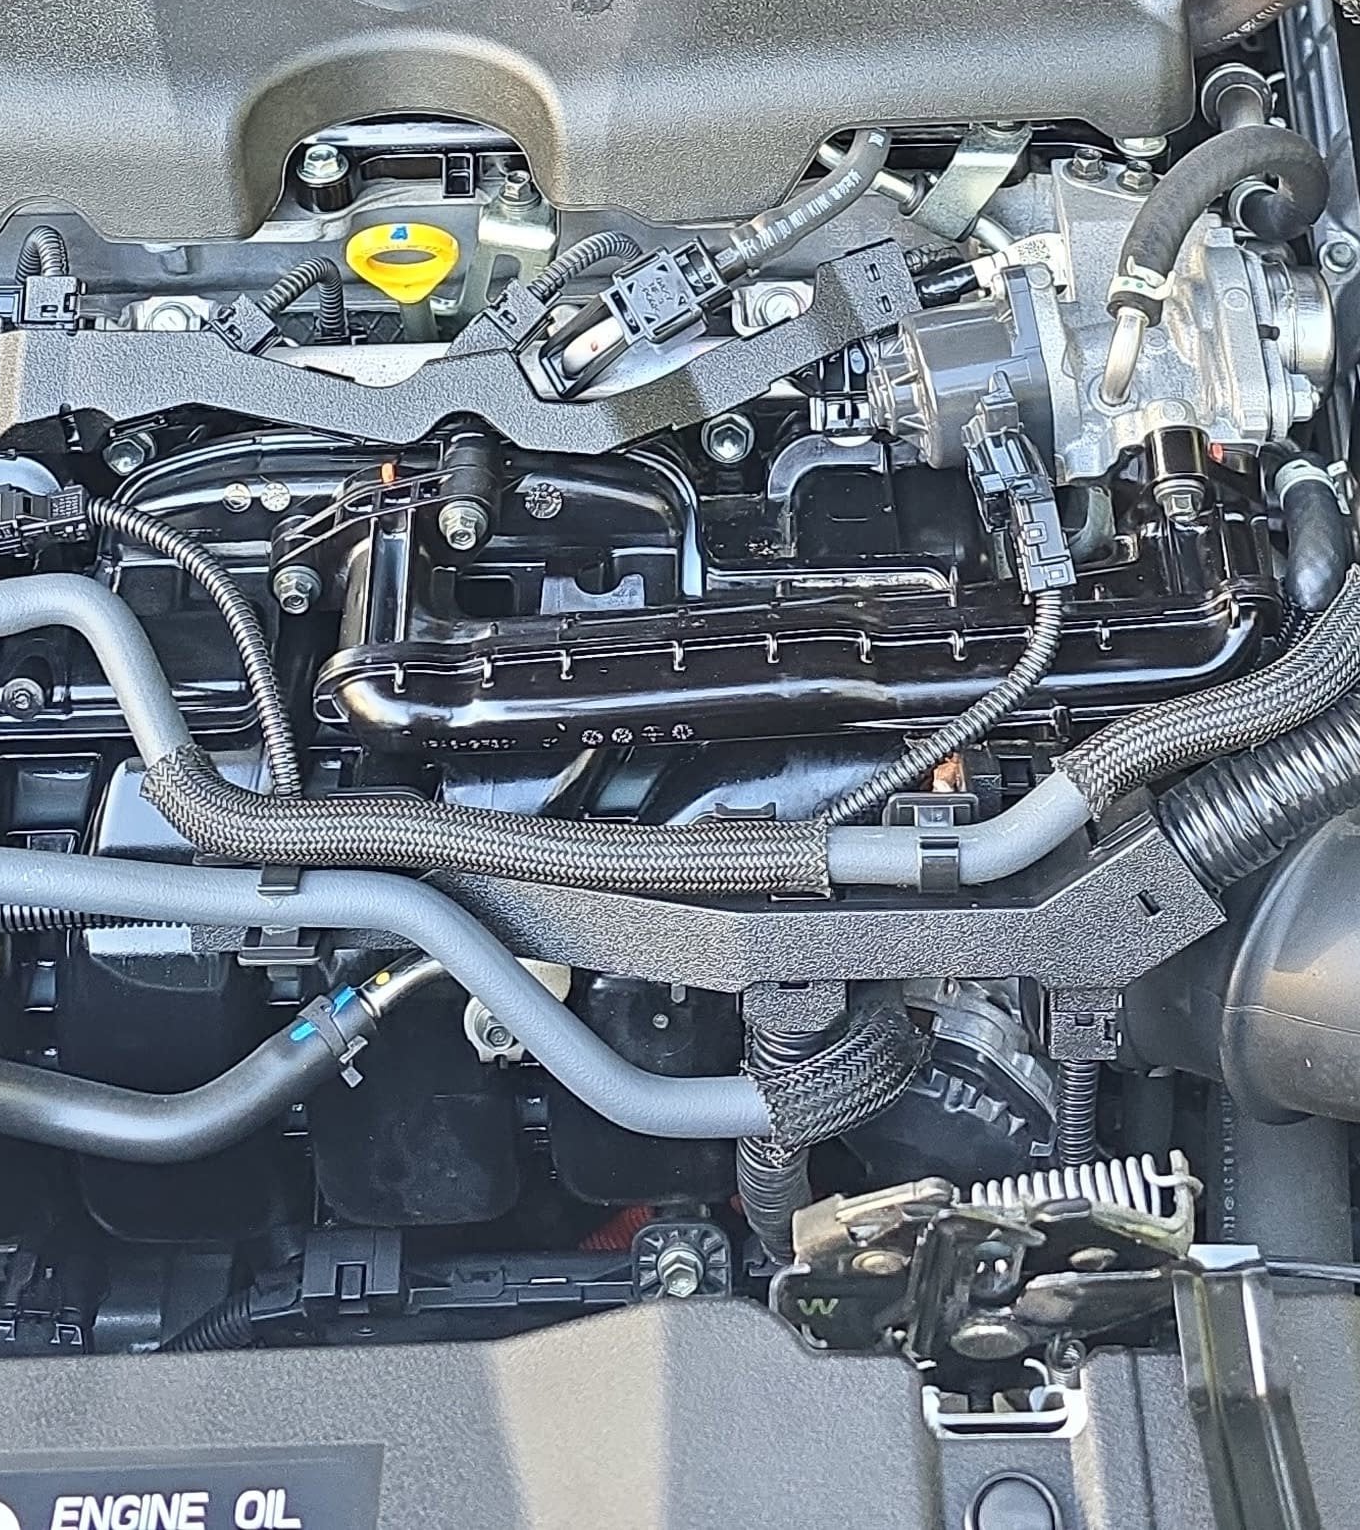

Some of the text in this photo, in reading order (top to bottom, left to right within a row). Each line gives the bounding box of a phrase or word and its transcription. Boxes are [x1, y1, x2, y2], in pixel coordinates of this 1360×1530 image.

[788, 210, 808, 230] NOT
[806, 194, 832, 218] KINK
[49, 1488, 303, 1530] ENGINE OIL
